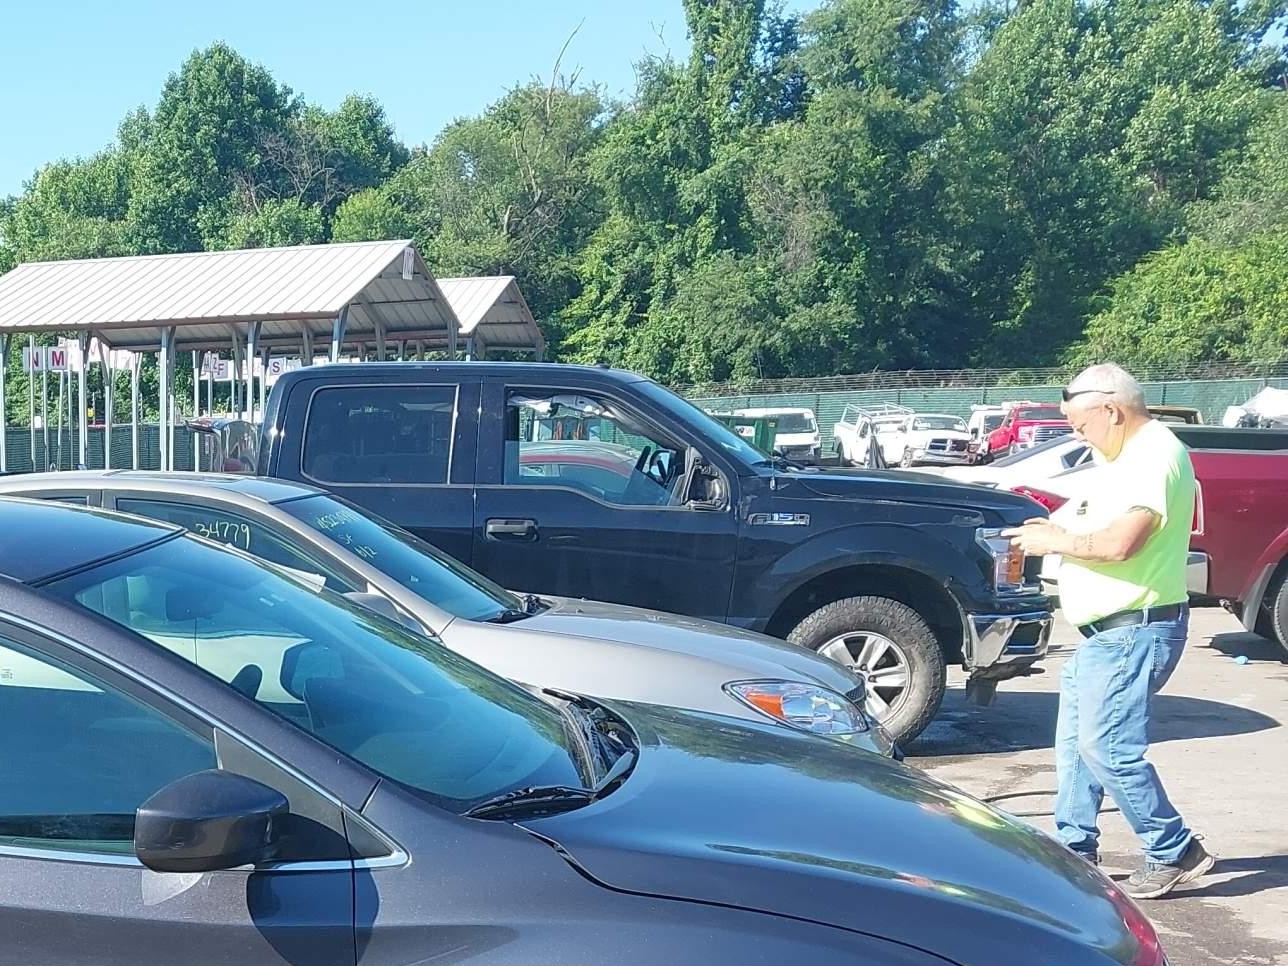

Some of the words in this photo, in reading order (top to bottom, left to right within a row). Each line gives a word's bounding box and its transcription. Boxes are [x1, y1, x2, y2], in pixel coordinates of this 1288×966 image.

[28, 351, 39, 367] N
[51, 350, 65, 367] M
[272, 361, 281, 373] S
[195, 520, 250, 549] 34779
